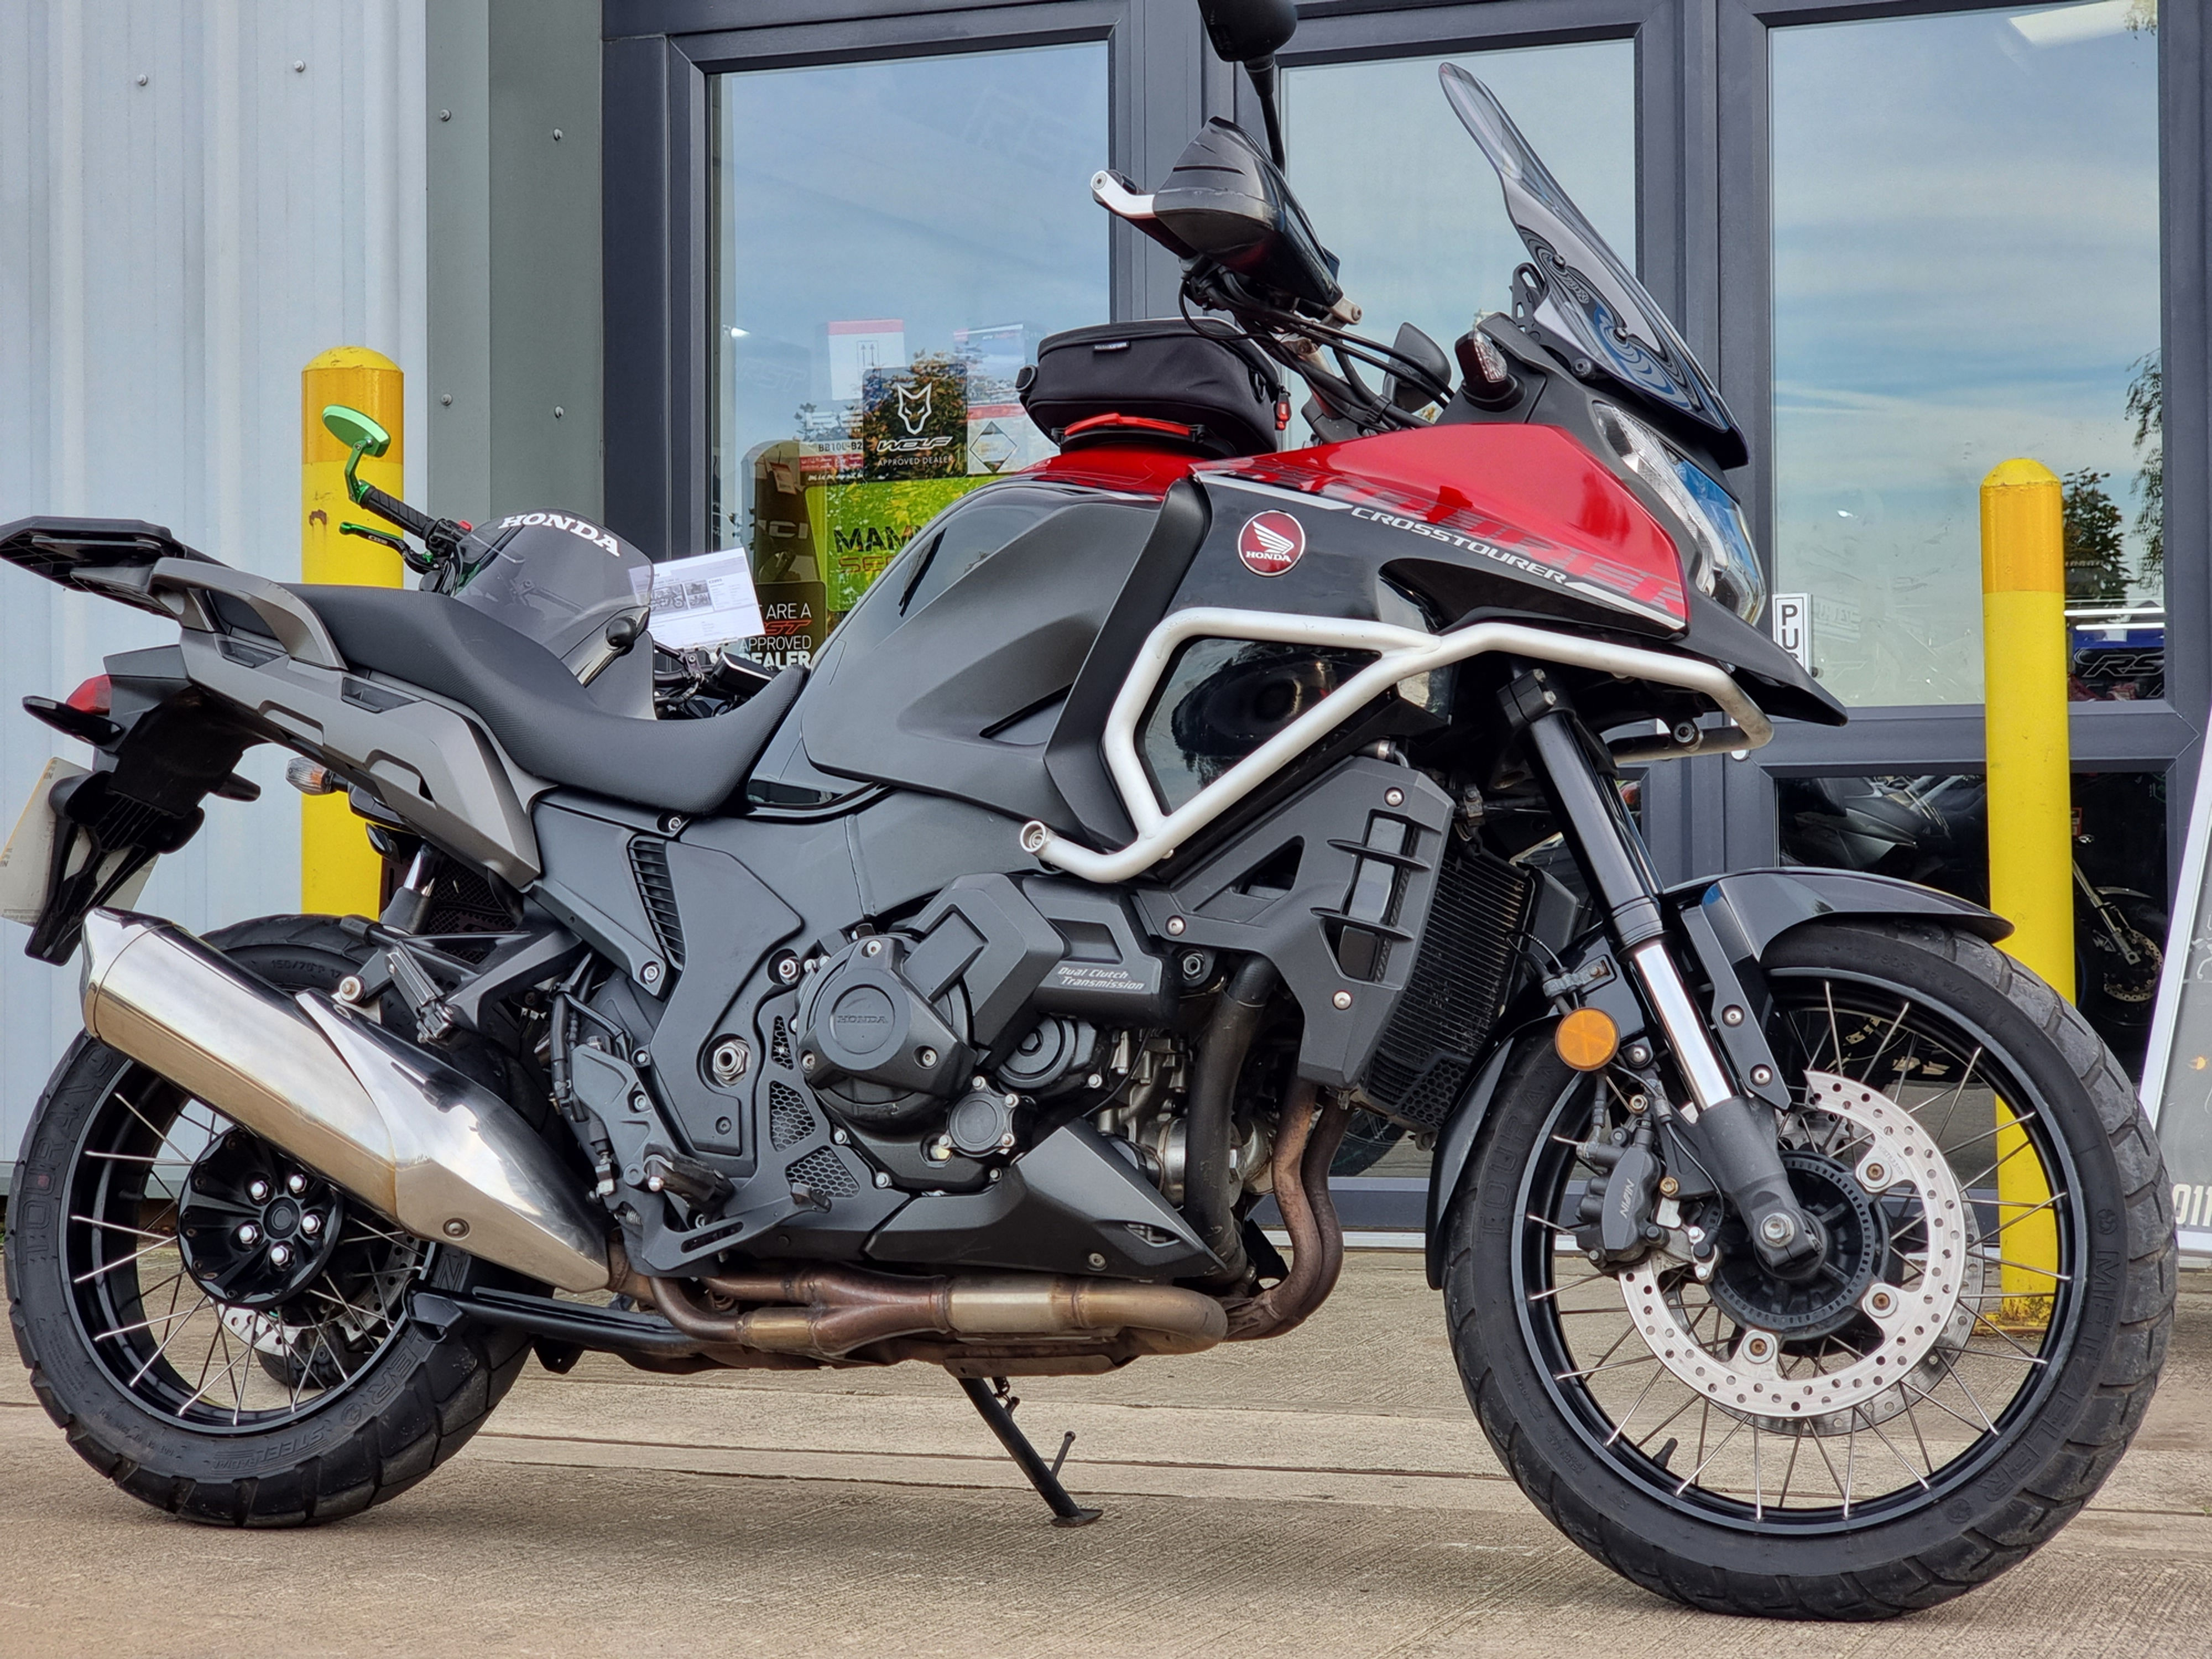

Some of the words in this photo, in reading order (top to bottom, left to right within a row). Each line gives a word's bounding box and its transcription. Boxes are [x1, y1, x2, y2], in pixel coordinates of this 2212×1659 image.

[877, 436, 953, 452] WOLF
[878, 457, 919, 467] APPROVED
[922, 455, 953, 465] DEALER
[498, 512, 620, 557] HONDA
[1351, 507, 1568, 585] CROSSTOURER
[1246, 551, 1292, 563] HONDA
[765, 603, 797, 619] ARE
[800, 602, 812, 619] A
[765, 619, 812, 635] ST
[1781, 604, 1799, 659] PU
[739, 635, 812, 652] APPROVED
[1057, 967, 1088, 976] Dual
[1088, 969, 1129, 979] Clutch
[1061, 976, 1145, 990] Transmission
[837, 1015, 888, 1024] HONDA
